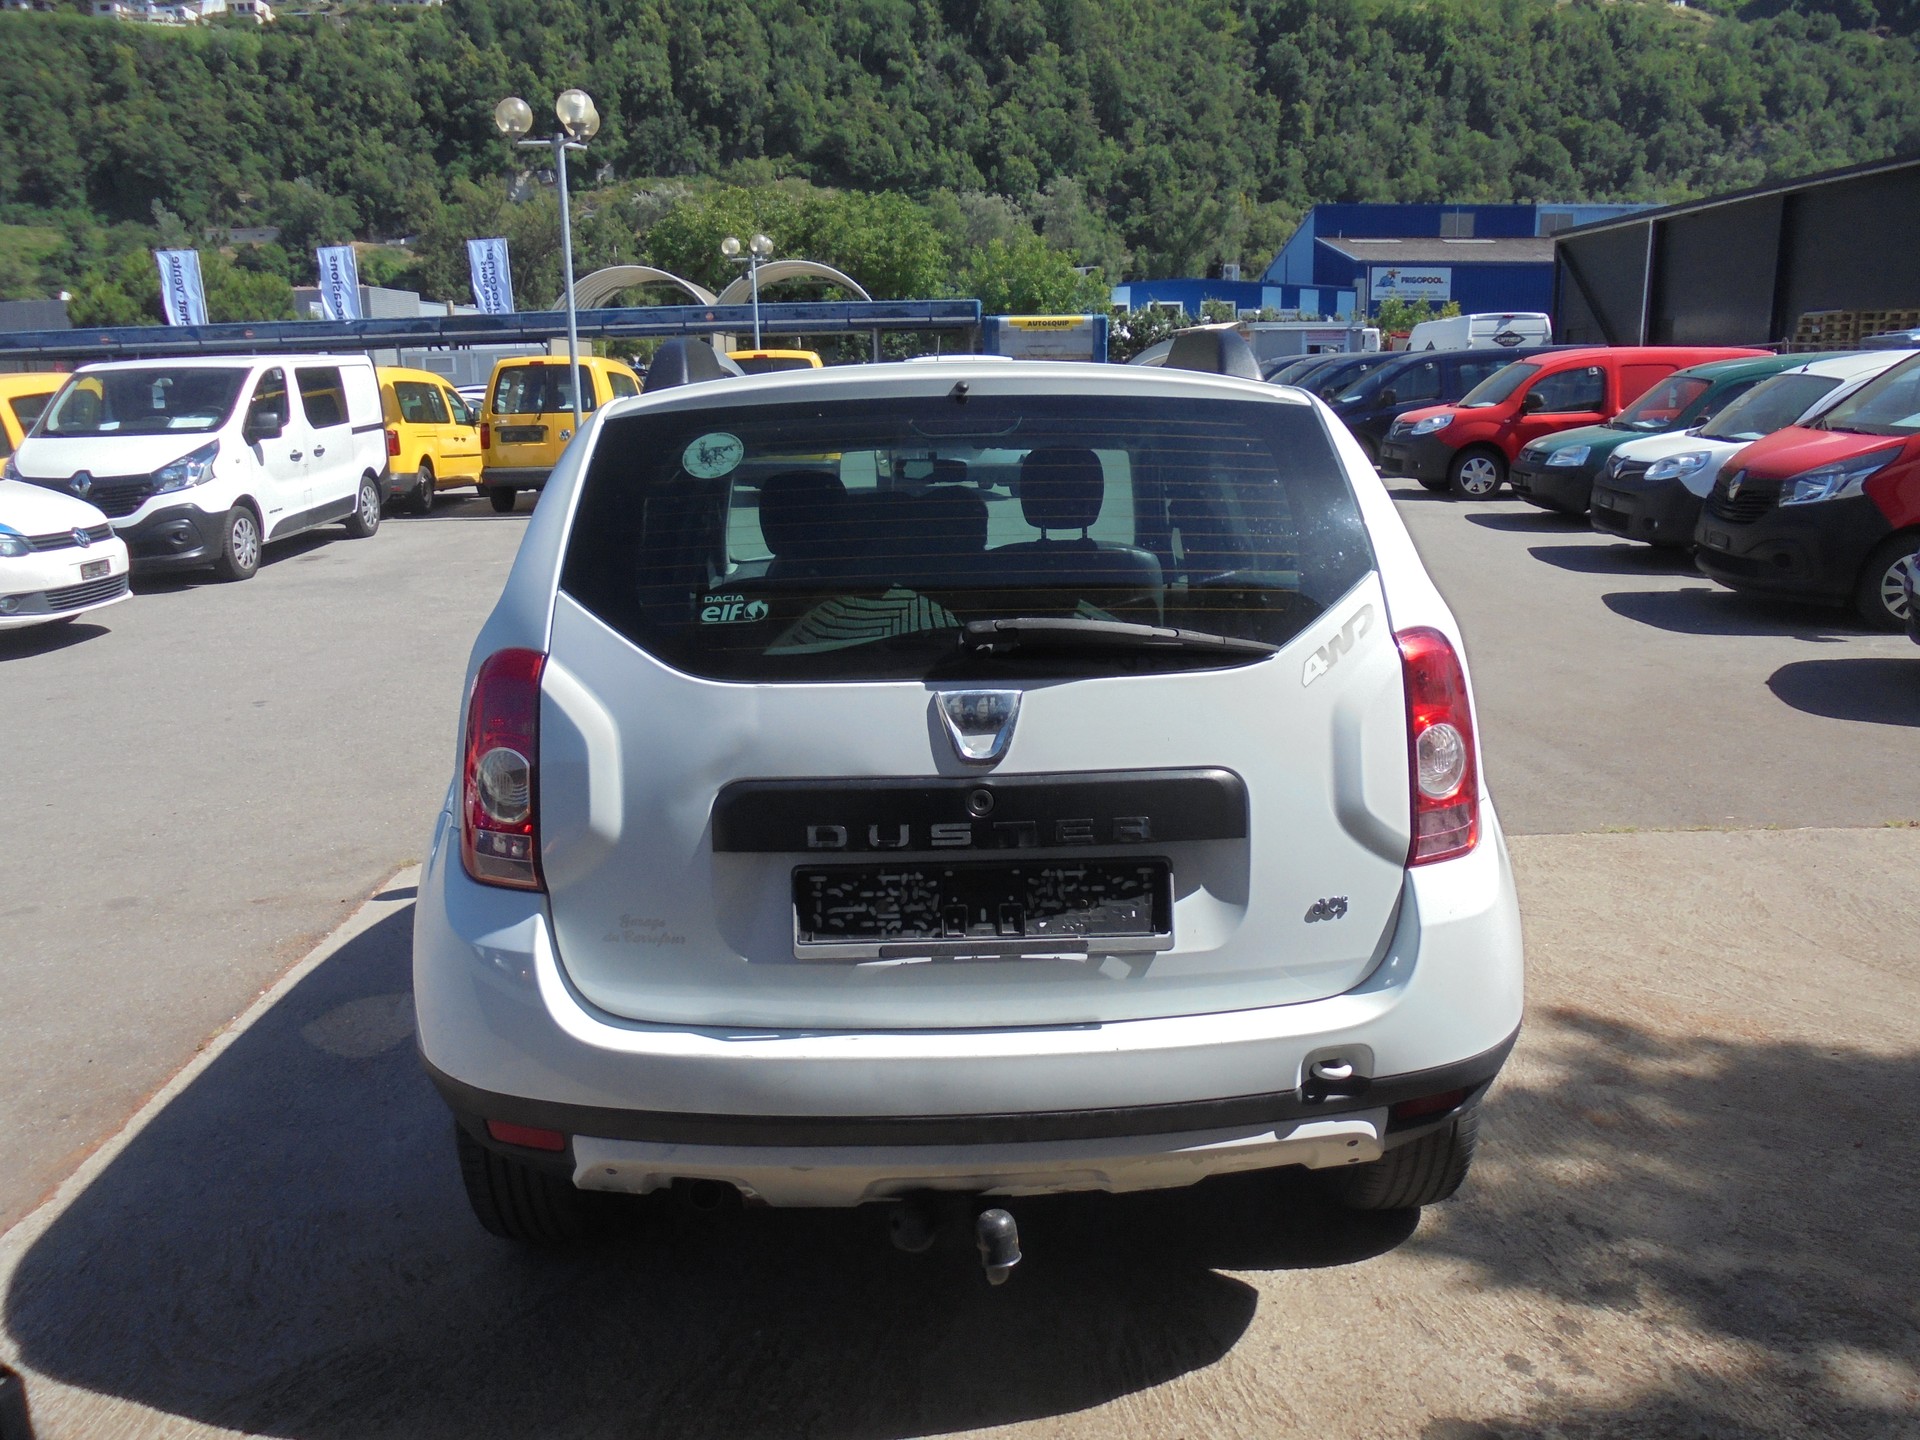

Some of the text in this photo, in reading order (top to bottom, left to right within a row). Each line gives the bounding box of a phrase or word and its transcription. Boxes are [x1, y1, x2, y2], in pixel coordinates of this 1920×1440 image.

[1401, 276, 1443, 284] FRIGOPOOL
[704, 595, 744, 603] DACIA
[701, 604, 744, 622] elf
[1302, 603, 1375, 688] 4WD
[806, 816, 1150, 849] DUSTER
